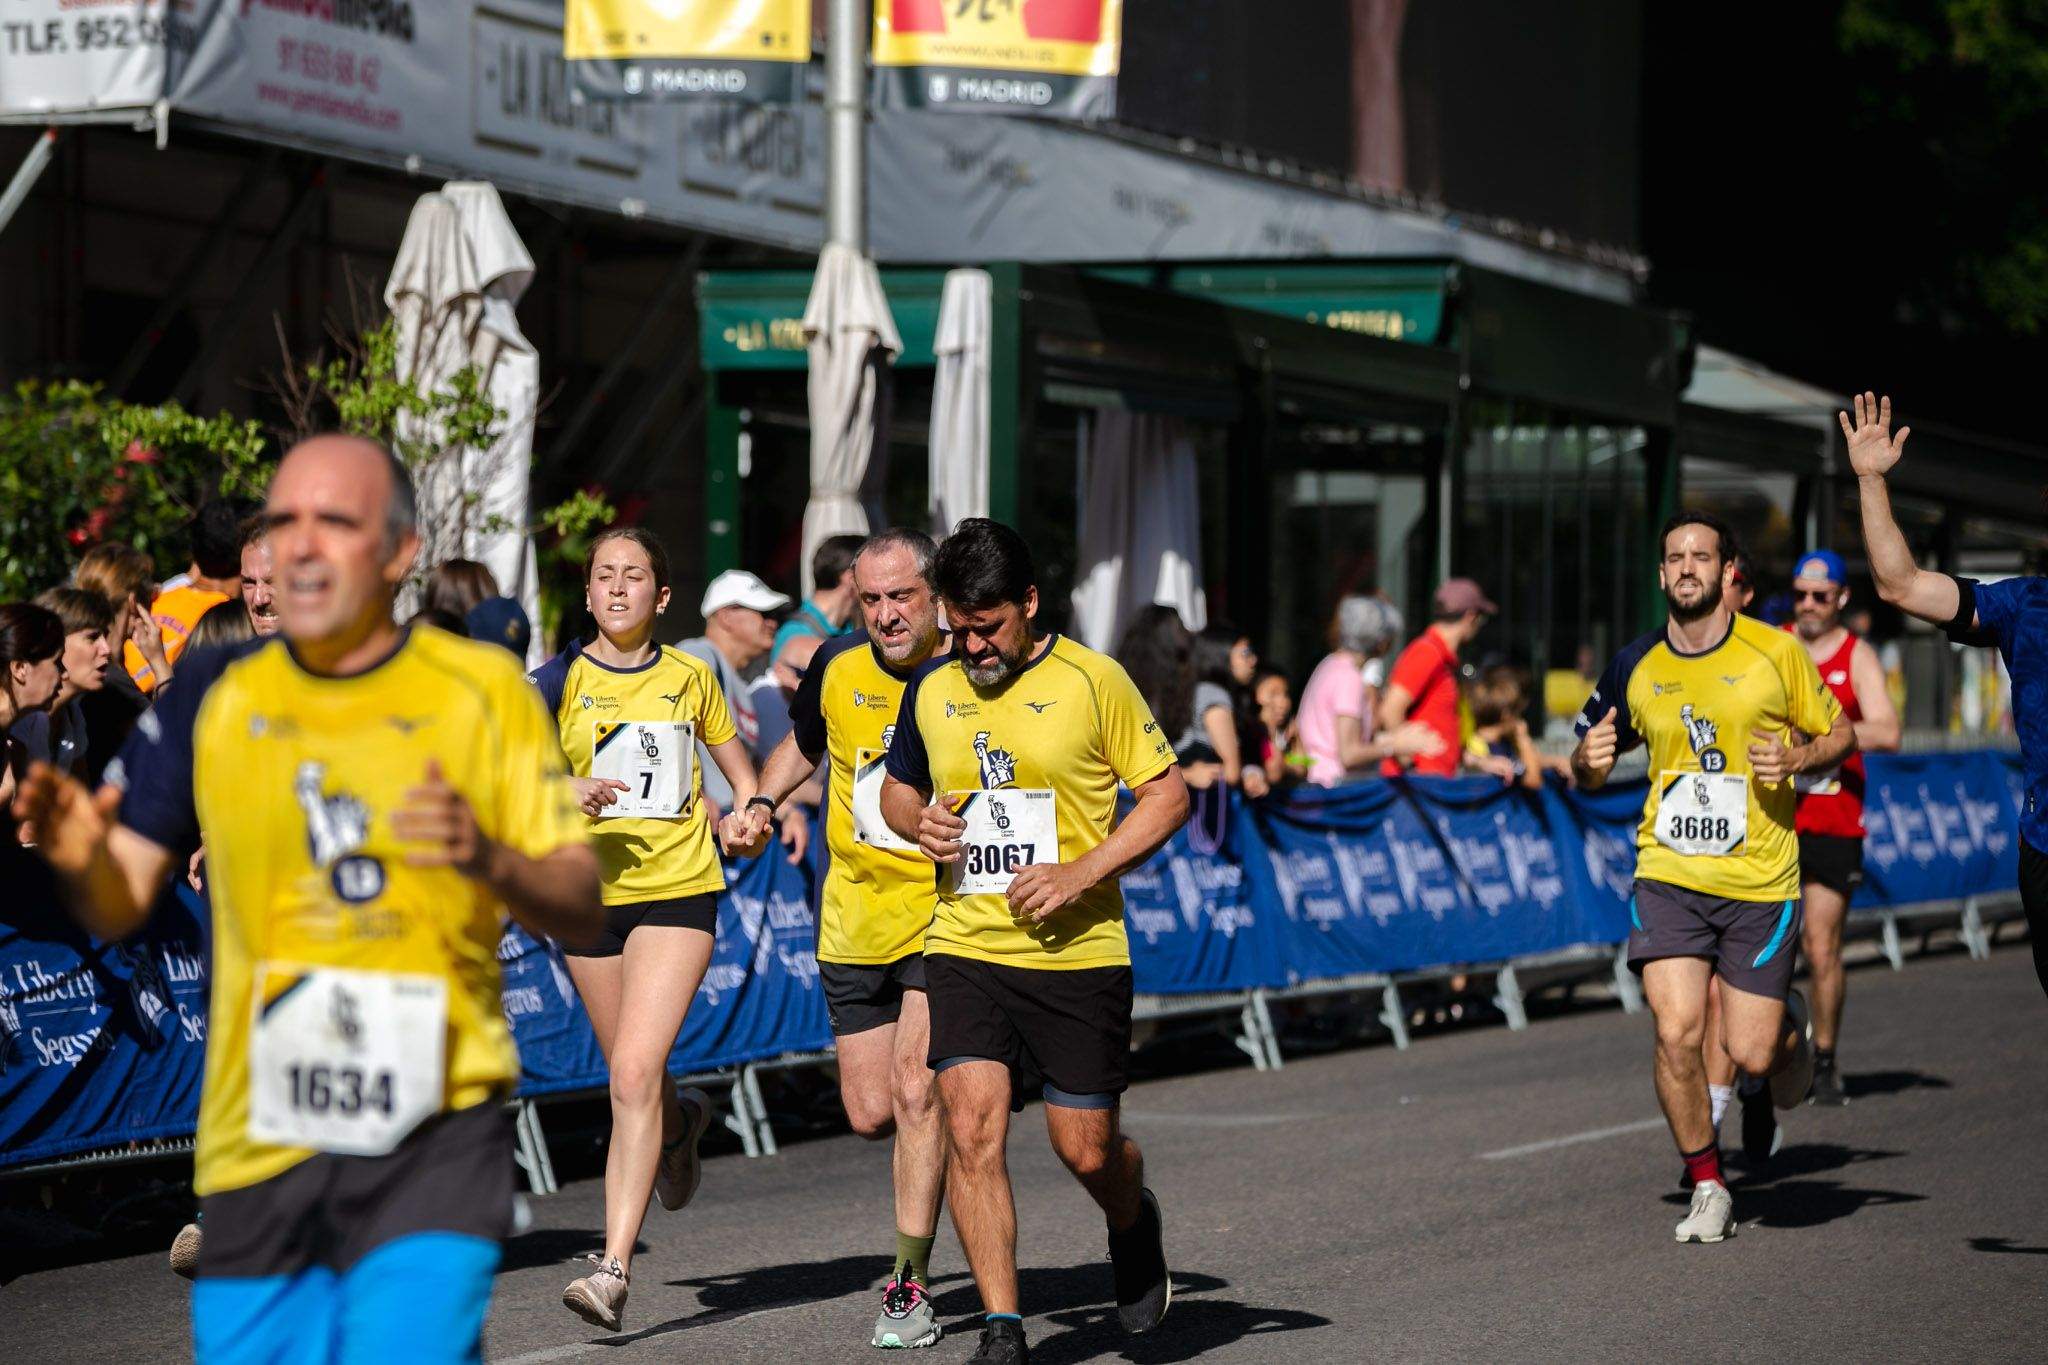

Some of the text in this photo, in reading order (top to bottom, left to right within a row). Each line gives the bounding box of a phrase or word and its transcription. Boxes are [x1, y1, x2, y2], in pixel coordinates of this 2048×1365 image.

[76, 16, 129, 50] 952
[652, 67, 747, 93] MADRID
[957, 77, 1053, 105] MADRID
[1705, 752, 1722, 770] 13
[640, 772, 653, 799] 7
[999, 818, 1008, 827] 13
[1670, 815, 1730, 840] 3688
[968, 843, 1035, 875] 3067
[286, 1060, 396, 1120] 1634
